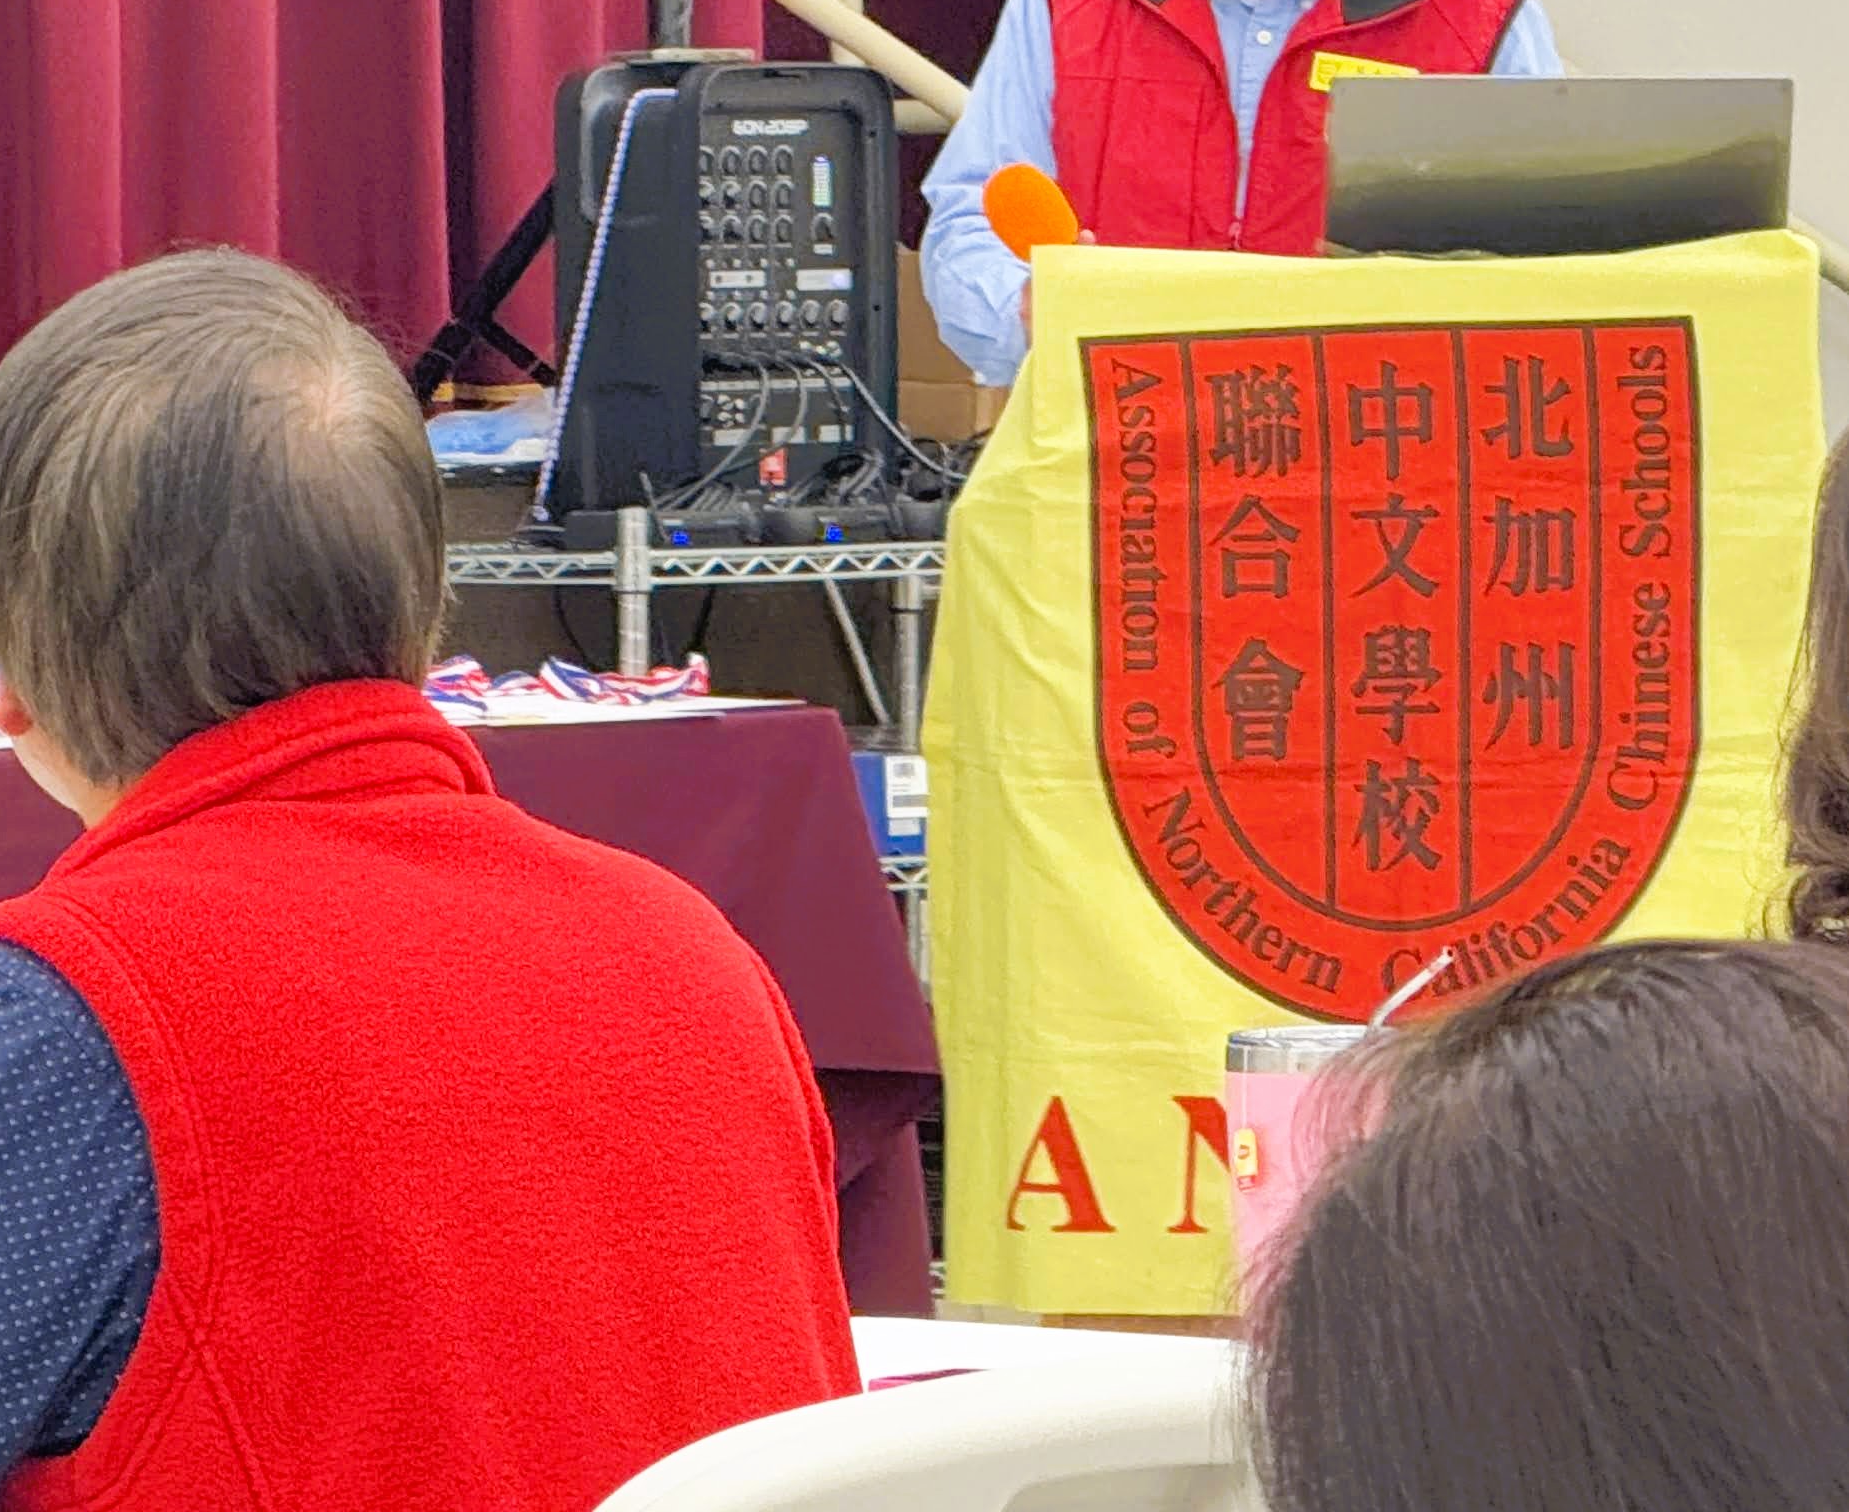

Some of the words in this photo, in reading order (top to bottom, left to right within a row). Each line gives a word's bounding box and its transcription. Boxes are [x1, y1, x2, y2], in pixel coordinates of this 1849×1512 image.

[1111, 358, 1168, 673] Association
[1204, 362, 1306, 761] 聯合會
[1482, 354, 1575, 752] 北加州
[1617, 343, 1672, 560] Schools
[1123, 700, 1177, 760] of
[1346, 359, 1443, 872] 中文學校
[1607, 581, 1672, 811] Chinese
[1143, 786, 1343, 994] Northern
